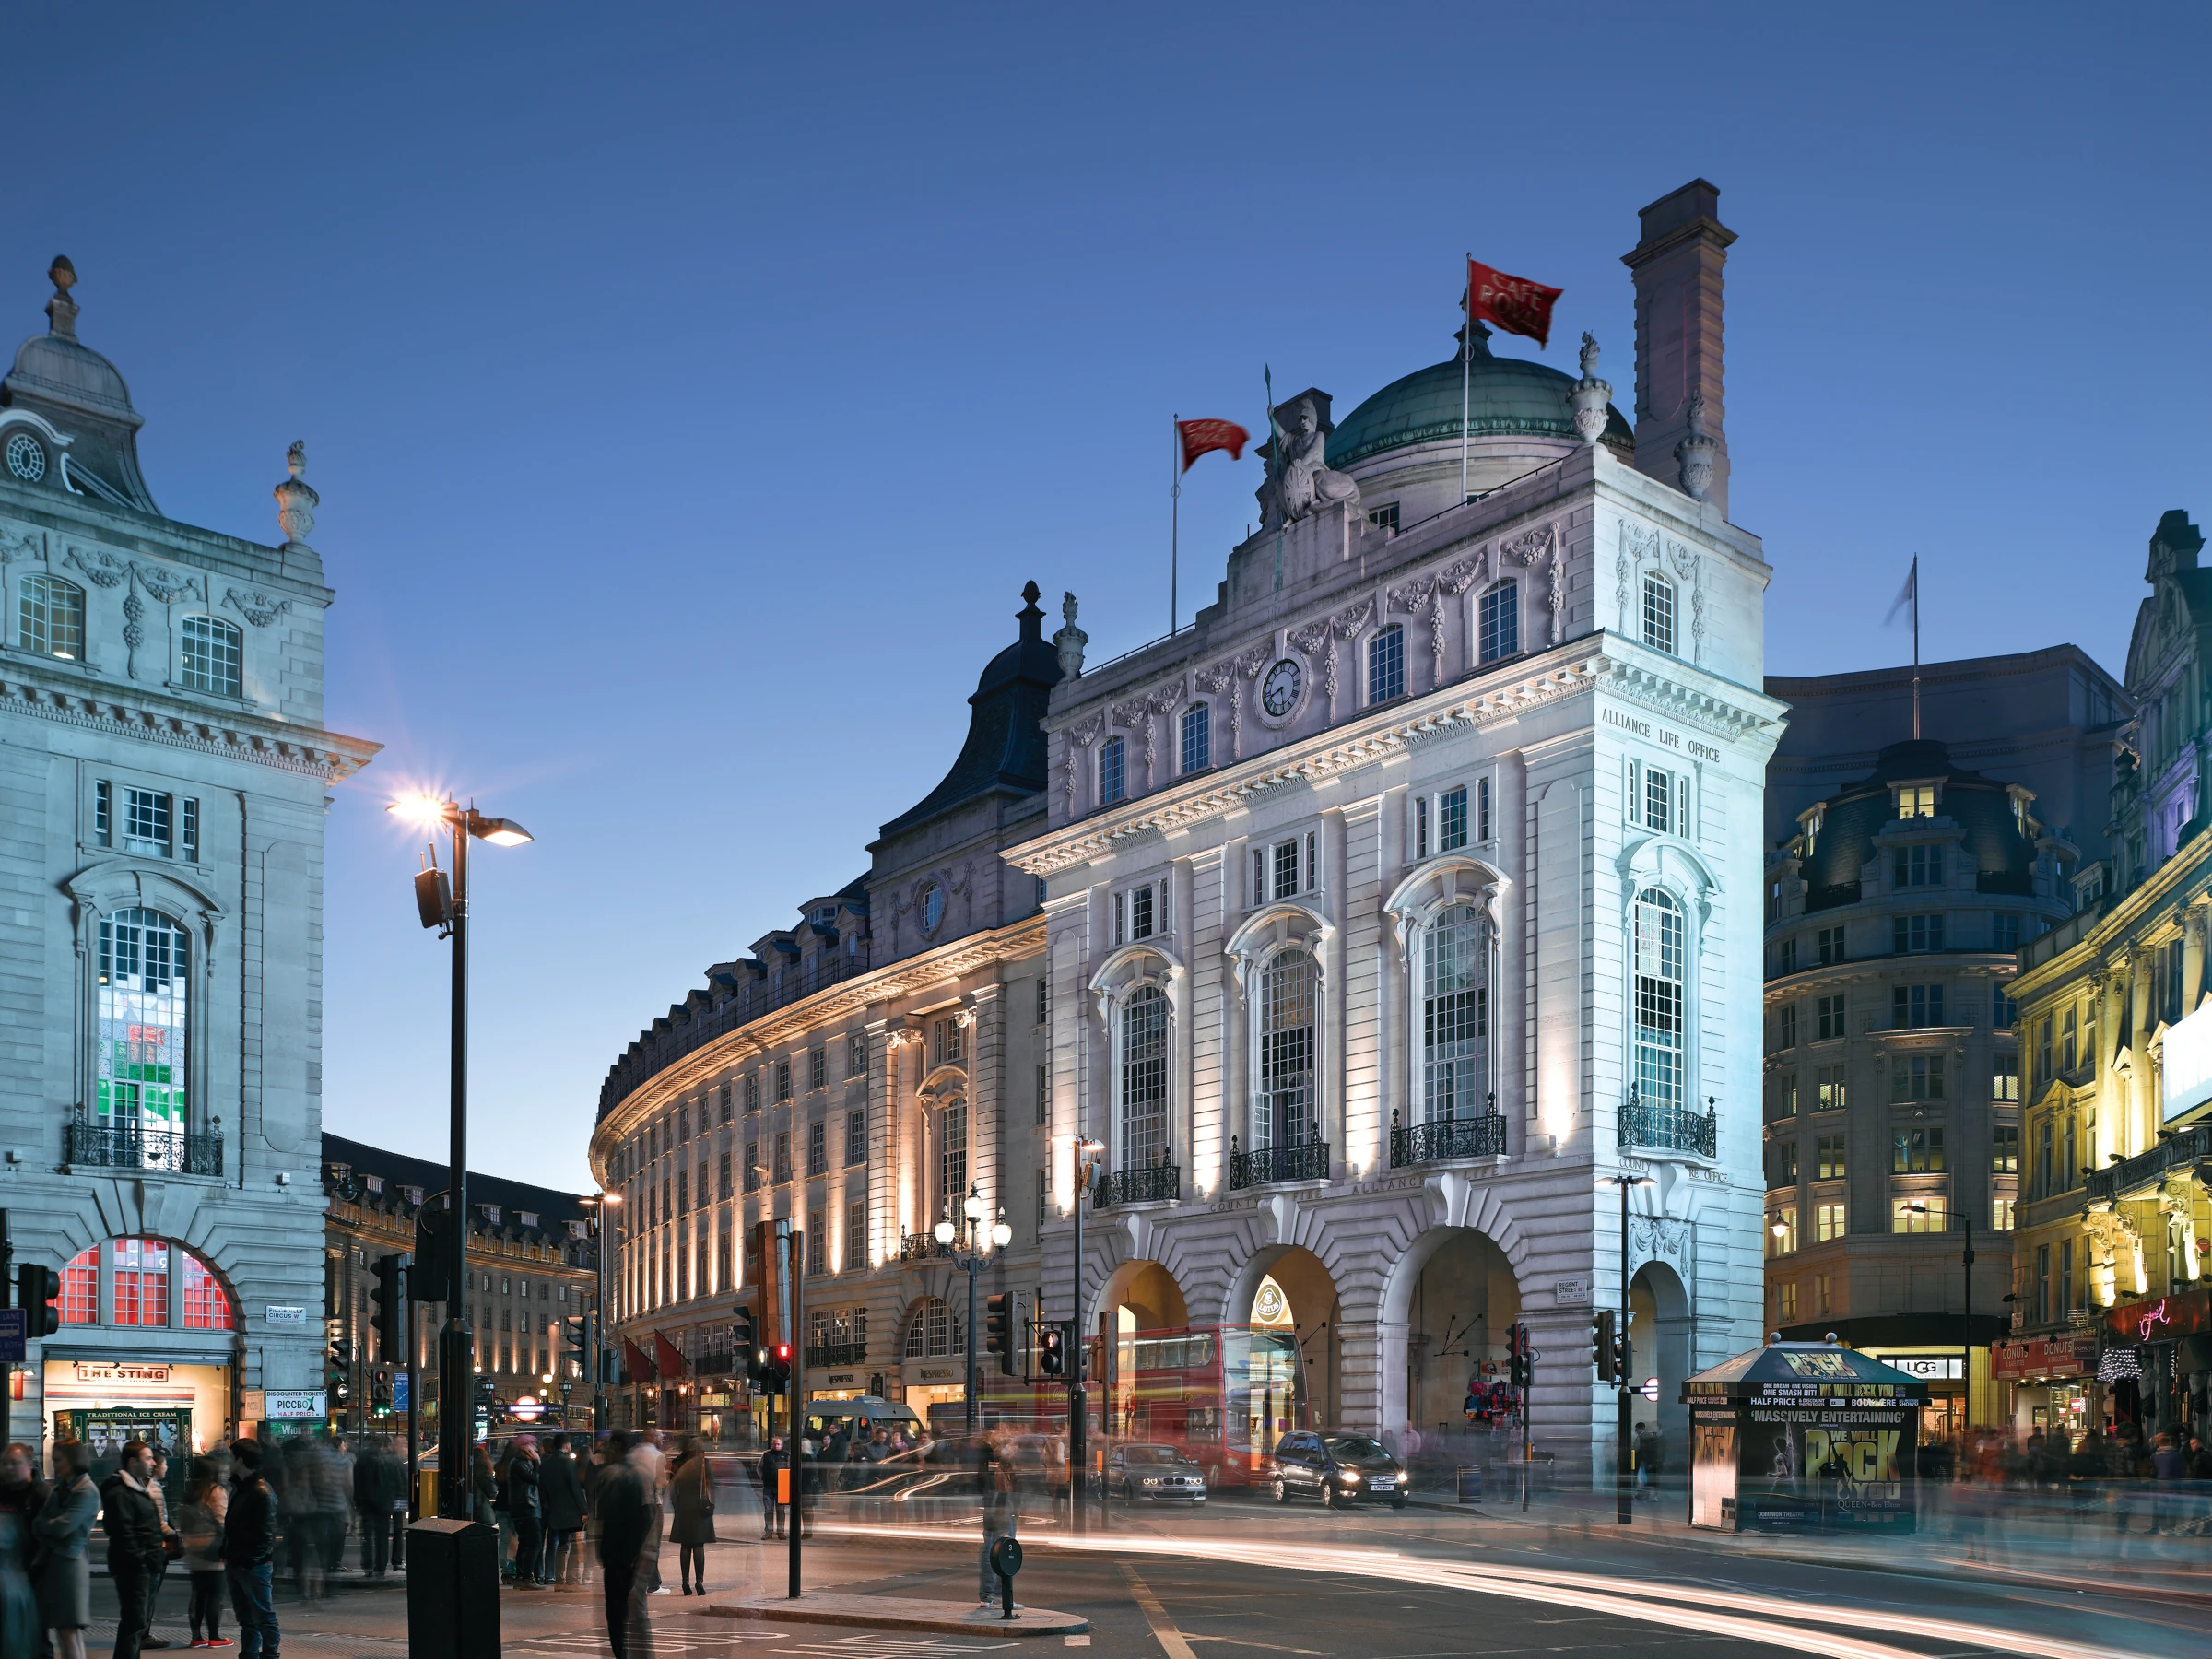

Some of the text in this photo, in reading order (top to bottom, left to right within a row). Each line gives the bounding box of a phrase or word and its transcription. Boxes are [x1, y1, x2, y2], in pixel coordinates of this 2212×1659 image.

[1602, 708, 1720, 763] ALLIANCE LIFE OFFICE
[1619, 1158, 1728, 1182] COUNTY RE OFFICE
[1210, 1166, 1500, 1212] COUNTY FIRE ALLIANCE LIFE
[1259, 1301, 1279, 1312] LOTUS
[2002, 1347, 2029, 1360] DONUTS
[2043, 1340, 2072, 1355] DONUTS
[1907, 1361, 1936, 1374] UGG
[81, 1370, 164, 1379] THE STING
[828, 1374, 853, 1385] NESPRESSO
[920, 1368, 954, 1381] NESPRESSO
[1819, 1383, 1831, 1397] WE
[1833, 1383, 1853, 1397] WILL
[1877, 1383, 1894, 1397] YOU
[277, 1396, 315, 1412] PICCBOX
[1830, 1430, 1877, 1442] WE WILL
[1853, 1482, 1901, 1500] YOU
[1837, 1500, 1866, 1512] QUEEN
[1871, 1500, 1882, 1509] Ben
[1884, 1500, 1901, 1509] Elton
